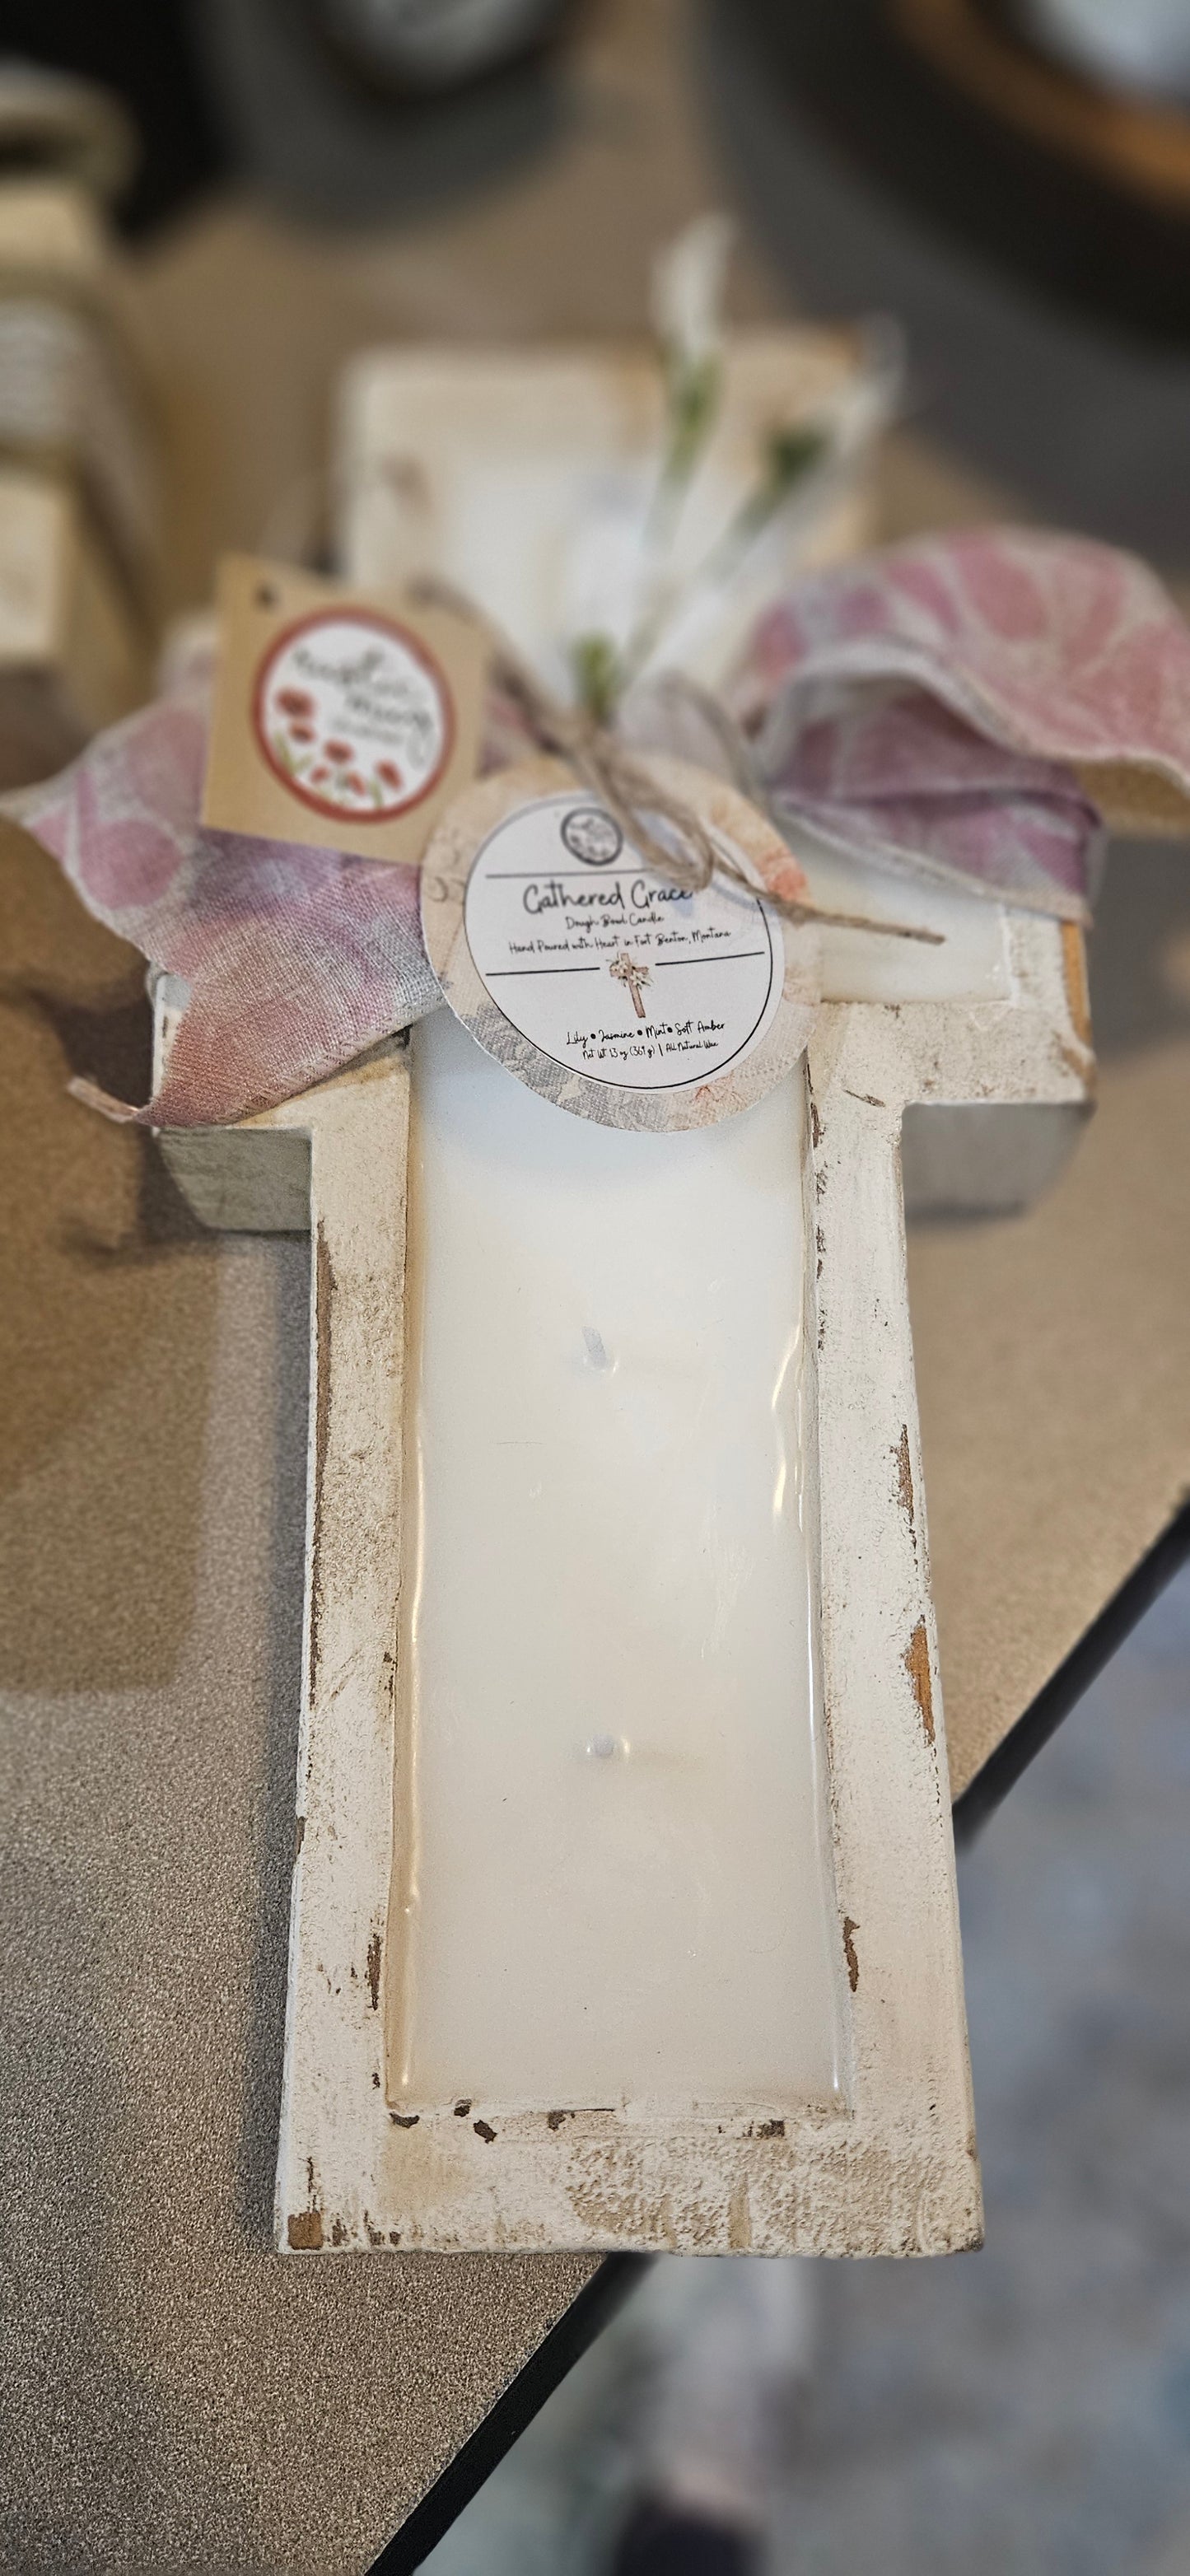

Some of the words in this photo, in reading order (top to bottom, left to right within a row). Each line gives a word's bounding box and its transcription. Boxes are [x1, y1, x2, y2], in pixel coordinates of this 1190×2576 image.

[522, 879, 625, 914] Gathered
[631, 879, 693, 909] Grace
[565, 915, 599, 933] Dough
[600, 913, 627, 927] Bowl
[629, 912, 665, 926] Candle
[508, 940, 535, 954] Hand
[537, 939, 571, 952] Poured
[572, 936, 594, 950] with
[595, 933, 620, 950] Heart
[634, 932, 651, 947] Fort
[655, 931, 692, 946] Benton,
[692, 926, 731, 944] Montana
[567, 1031, 588, 1048] Lily
[599, 1029, 635, 1043] Jasmine
[646, 1022, 668, 1038] Mint
[674, 1019, 693, 1036] Soft
[698, 1020, 725, 1034] Amber
[582, 1048, 595, 1060] Net
[609, 1048, 618, 1058] 13
[665, 1043, 677, 1052] All
[677, 1040, 703, 1052] Natural
[703, 1040, 719, 1050] Wax
